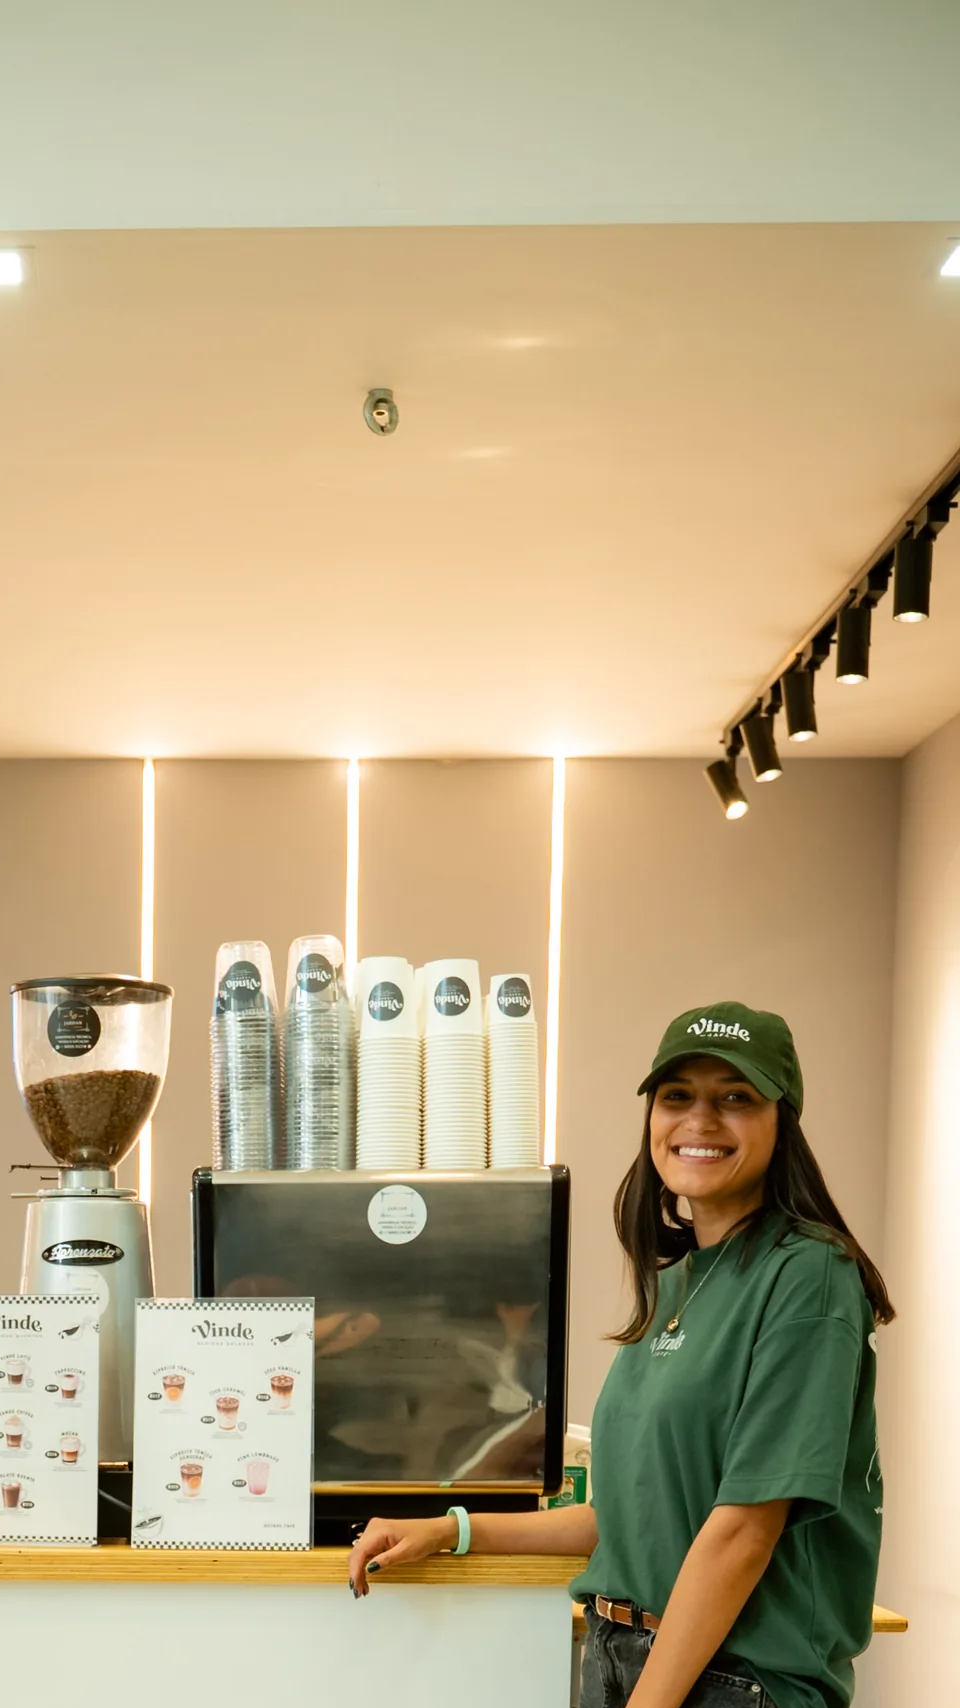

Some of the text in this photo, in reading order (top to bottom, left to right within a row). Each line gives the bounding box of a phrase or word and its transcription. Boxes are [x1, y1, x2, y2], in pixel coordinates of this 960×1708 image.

[297, 970, 332, 982] Vinde
[226, 978, 261, 991] Vinde
[369, 999, 403, 1012] Vinde
[435, 993, 470, 1007] Vinde
[499, 995, 531, 1008] Vinde
[687, 1017, 750, 1042] Vinde
[191, 1320, 254, 1340] Vinde
